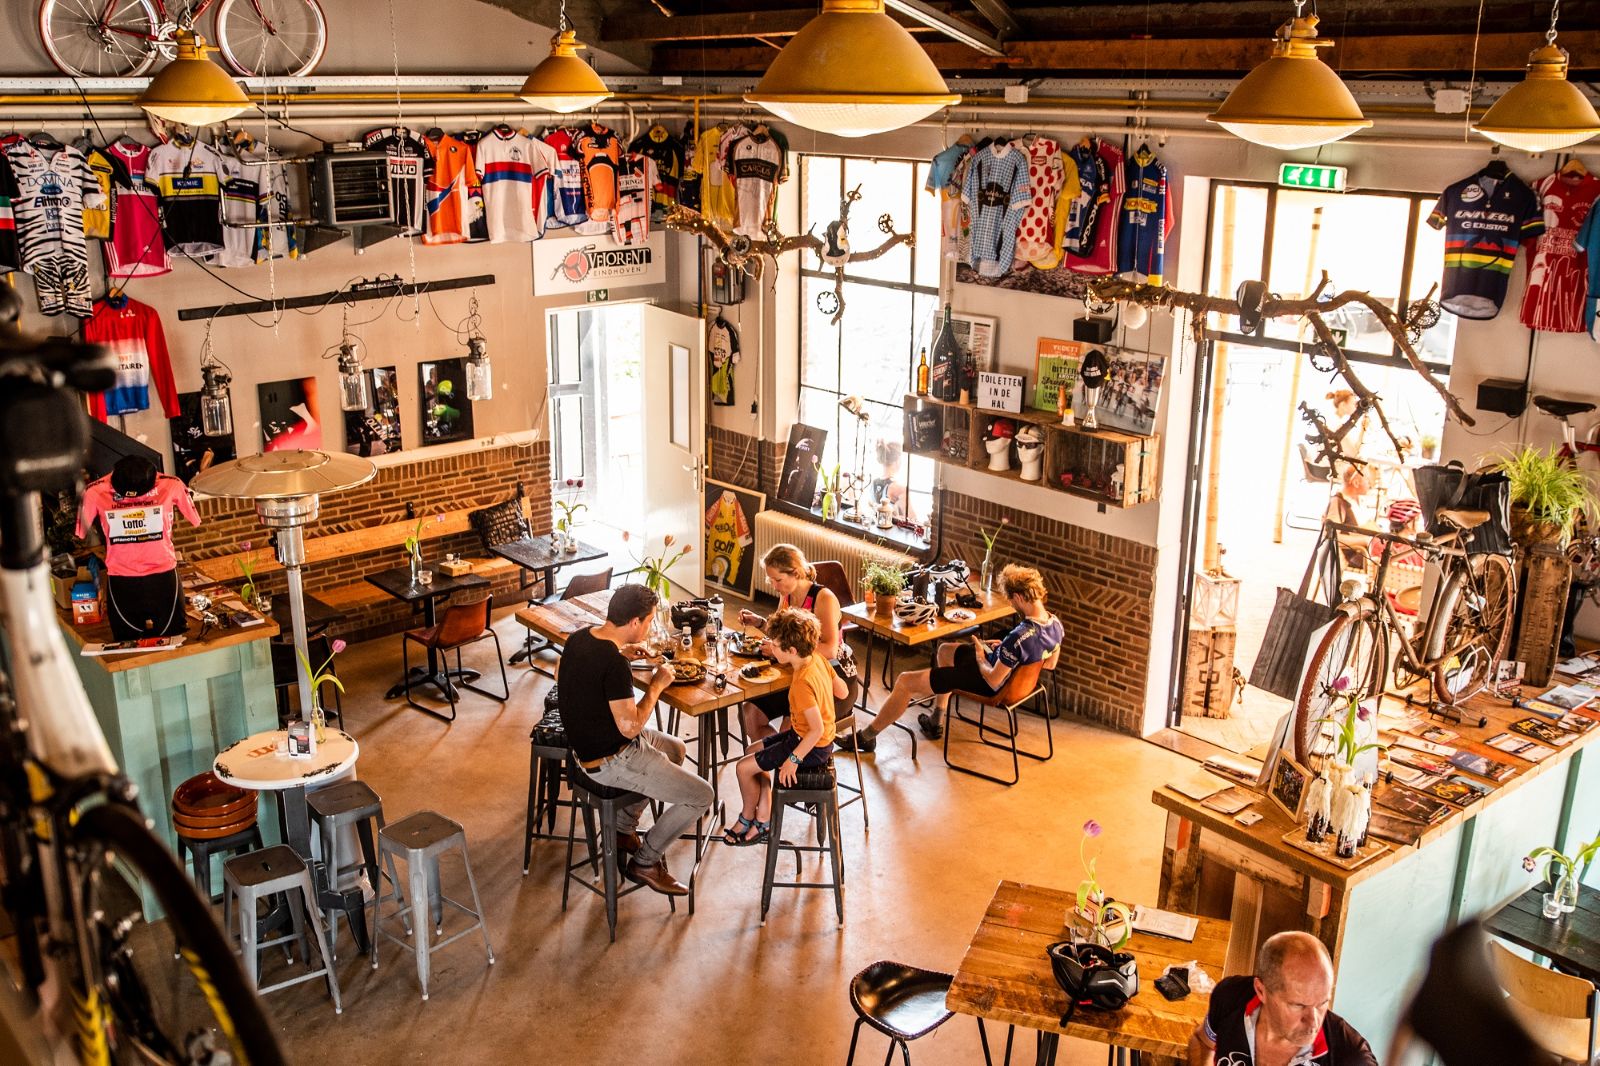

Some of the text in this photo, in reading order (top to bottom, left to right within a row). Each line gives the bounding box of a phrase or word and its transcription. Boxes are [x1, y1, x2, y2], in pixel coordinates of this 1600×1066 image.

[27, 176, 74, 187] DOMINA
[593, 267, 641, 277] EINDHOVEN
[981, 374, 1023, 387] TOILETTEN
[989, 388, 1010, 397] IN DE
[991, 399, 1005, 409] HAL
